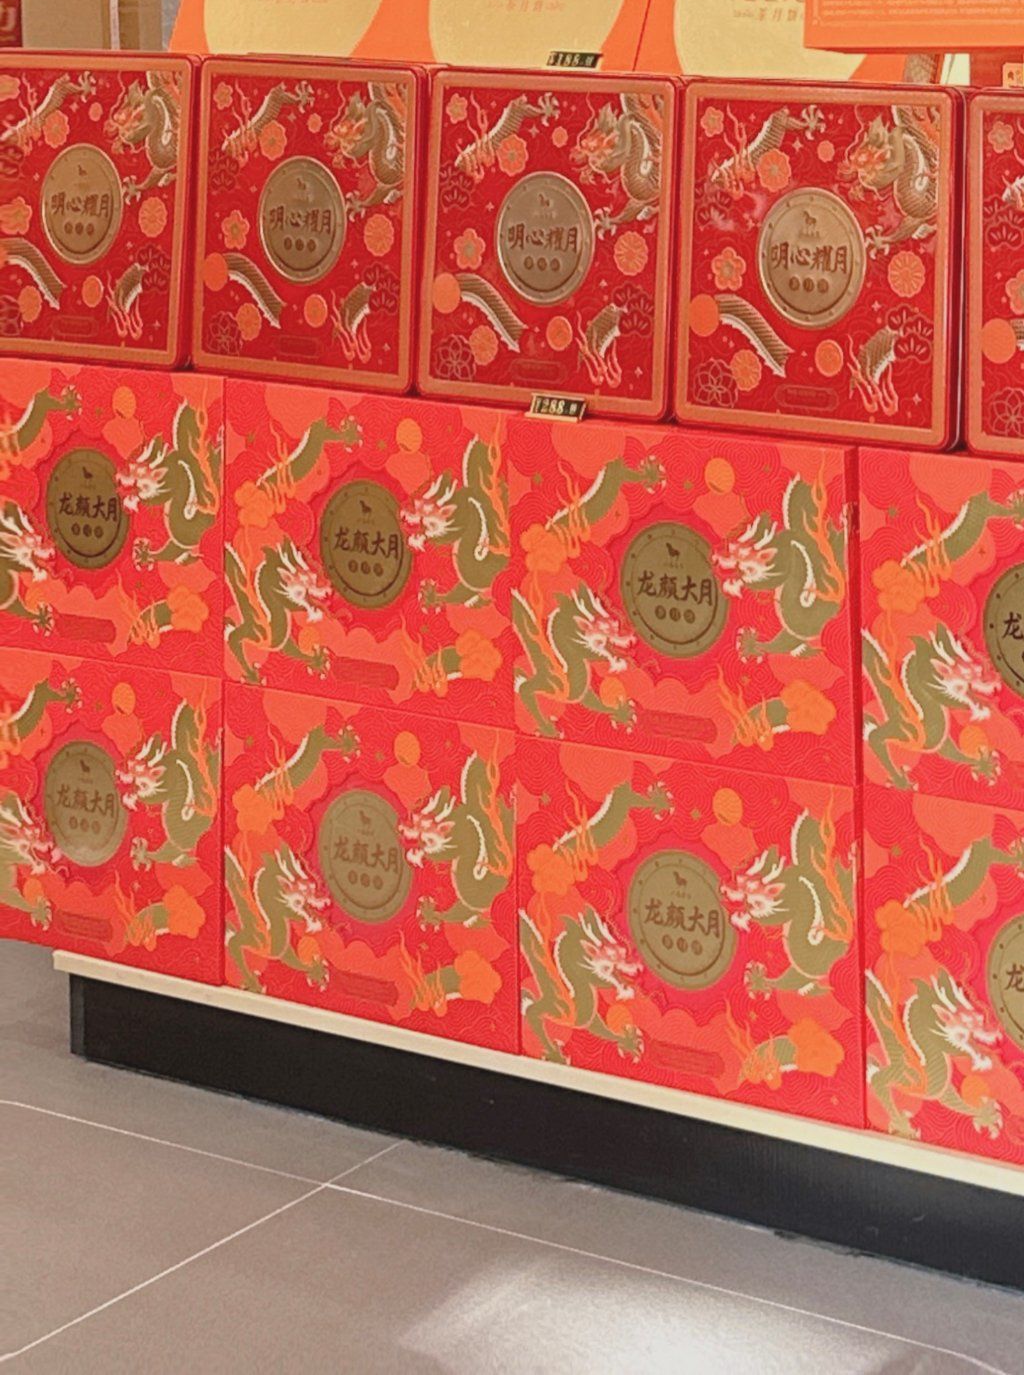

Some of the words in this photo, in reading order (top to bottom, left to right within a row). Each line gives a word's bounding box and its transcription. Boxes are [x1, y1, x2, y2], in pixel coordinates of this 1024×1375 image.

[59, 492, 119, 523] 龙颜大月
[334, 527, 400, 561] 龙颜大月
[637, 570, 712, 607] 龙颜大月
[57, 785, 117, 817] 龙颜大月
[334, 836, 399, 874] 龙颜大月
[644, 897, 720, 939] 龙颜大月
